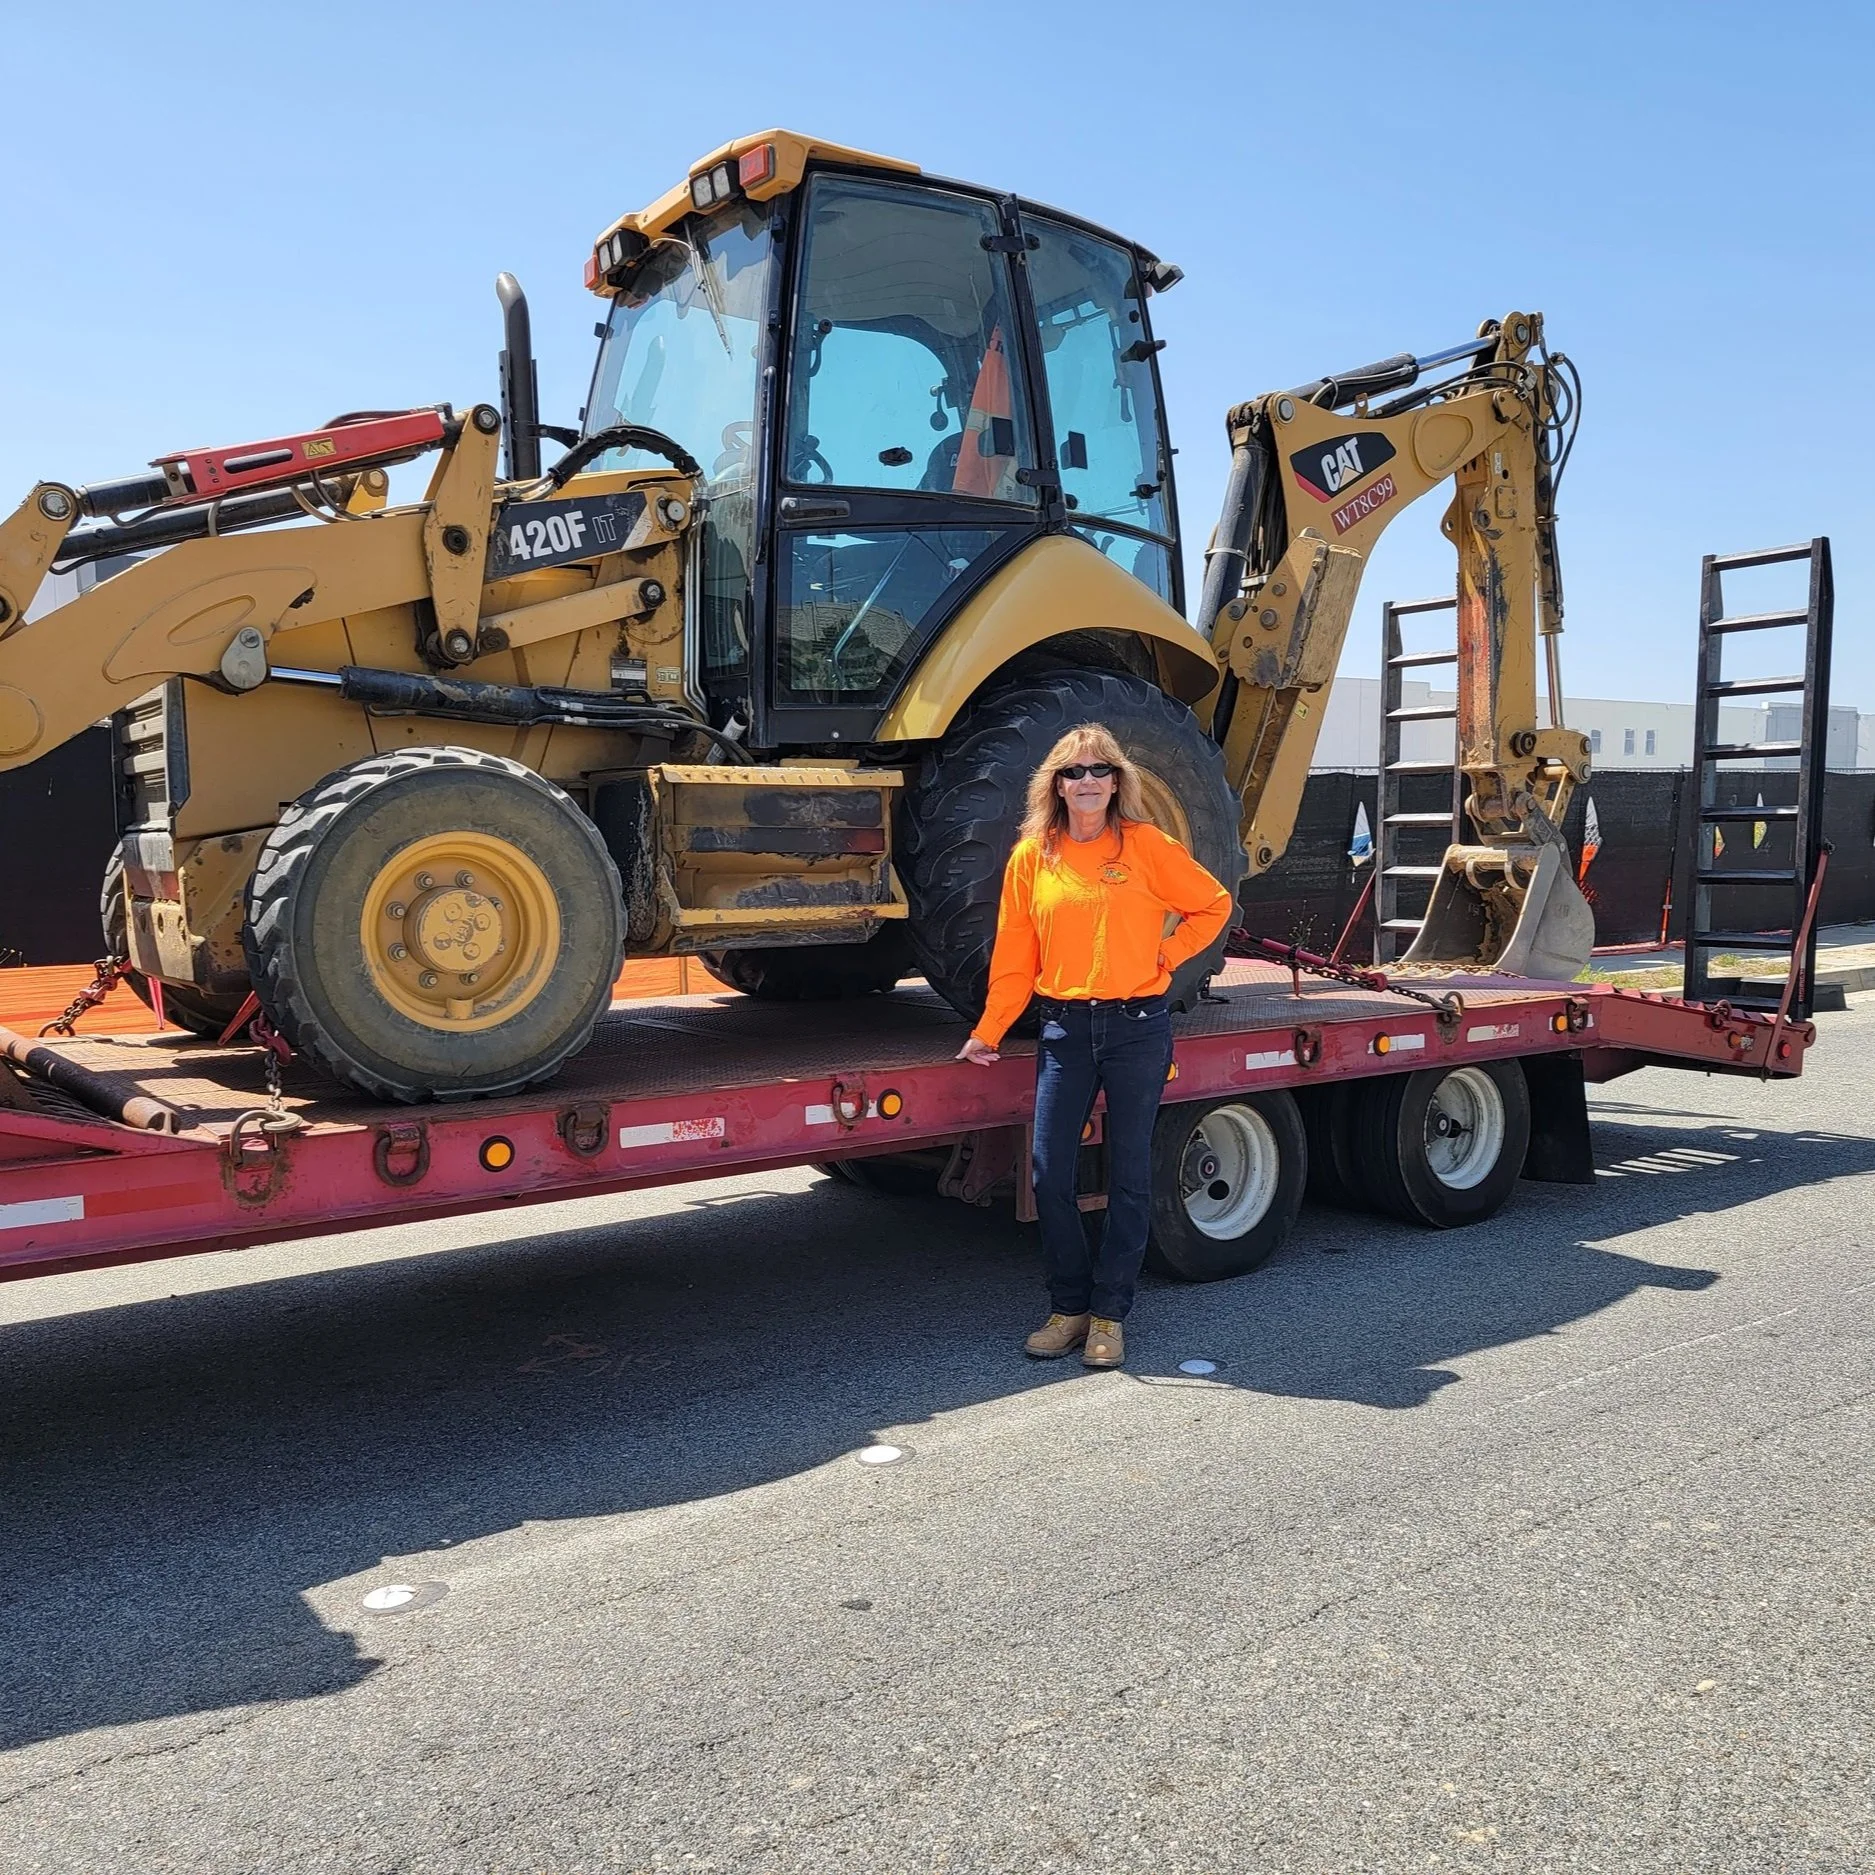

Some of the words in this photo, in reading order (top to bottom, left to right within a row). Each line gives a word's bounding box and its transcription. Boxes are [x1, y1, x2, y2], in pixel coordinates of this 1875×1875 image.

[1321, 437, 1364, 491] CAT
[1335, 478, 1393, 529] WT8C99
[510, 511, 586, 560] 420F
[592, 513, 617, 543] IT
